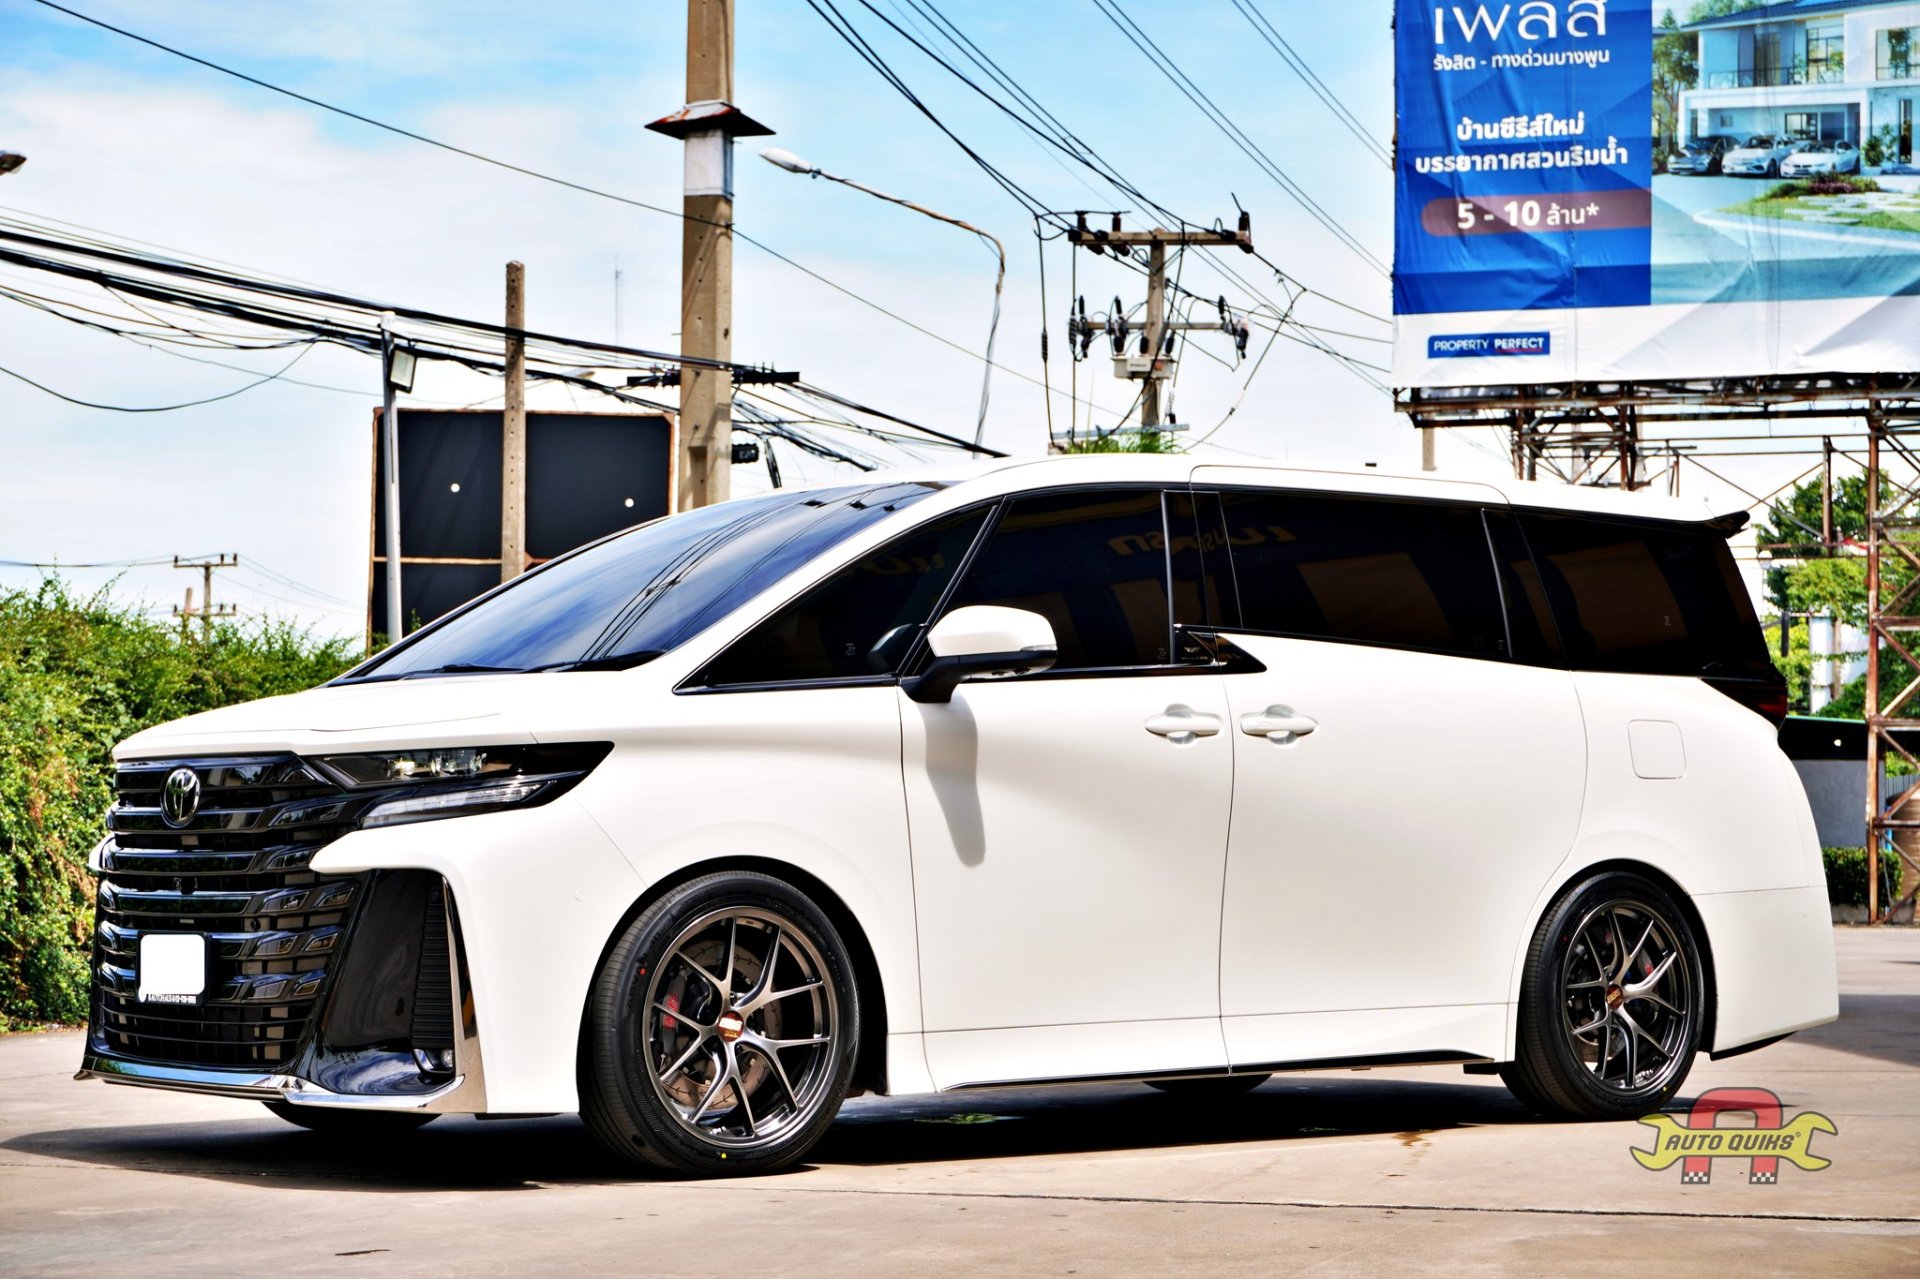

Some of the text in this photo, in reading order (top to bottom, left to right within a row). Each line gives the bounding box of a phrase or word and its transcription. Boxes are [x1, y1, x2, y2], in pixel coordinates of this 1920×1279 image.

[1433, 52, 1475, 71] รังสิต
[1492, 48, 1610, 68] ทางด่วนบางพูน
[1457, 111, 1584, 141] บ้านซีรีส์ใหม่
[1415, 136, 1628, 173] บรรยากาศสวนริมน้ำ
[1458, 203, 1475, 229] 5
[1504, 200, 1541, 227] 10
[1434, 337, 1544, 351] PROPERTY PERFECT
